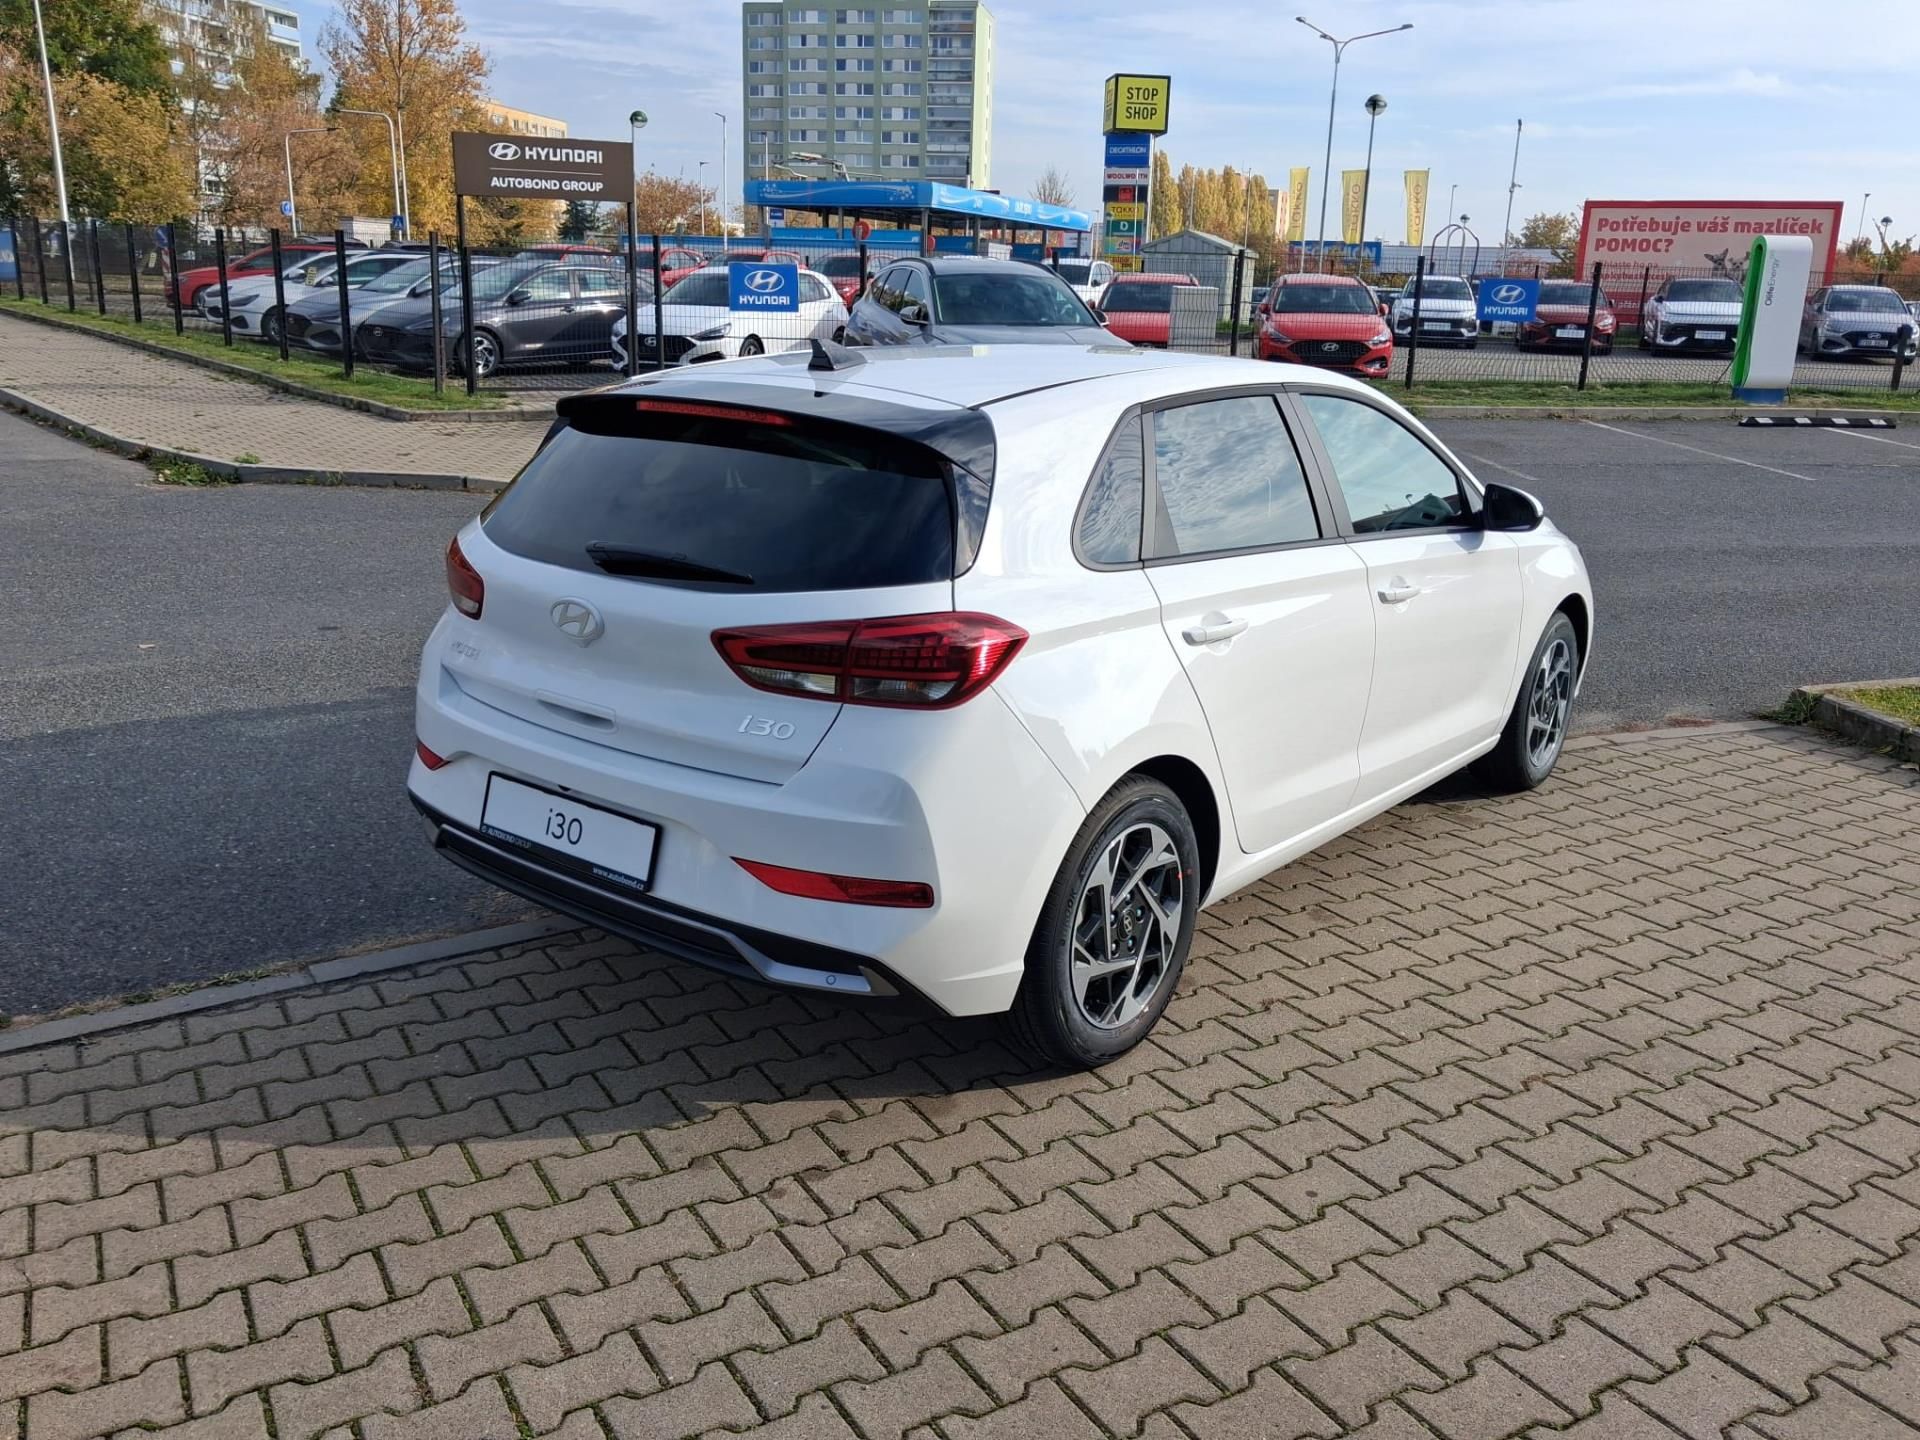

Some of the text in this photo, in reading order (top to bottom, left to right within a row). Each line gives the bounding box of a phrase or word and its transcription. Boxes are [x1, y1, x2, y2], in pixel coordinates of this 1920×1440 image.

[1126, 86, 1159, 102] STOP
[1125, 106, 1158, 121] SHOP
[524, 146, 603, 164] HYUNDAI
[1109, 146, 1147, 154] DECATHLON
[490, 176, 604, 193] AUTOBOND GROUP
[1597, 215, 1824, 236] Potřebuje váš mazlíček
[1594, 238, 1674, 253] POMOC?
[739, 295, 791, 305] HYUNDAI
[1484, 306, 1528, 316] HYUNDAI
[545, 808, 583, 845] i30
